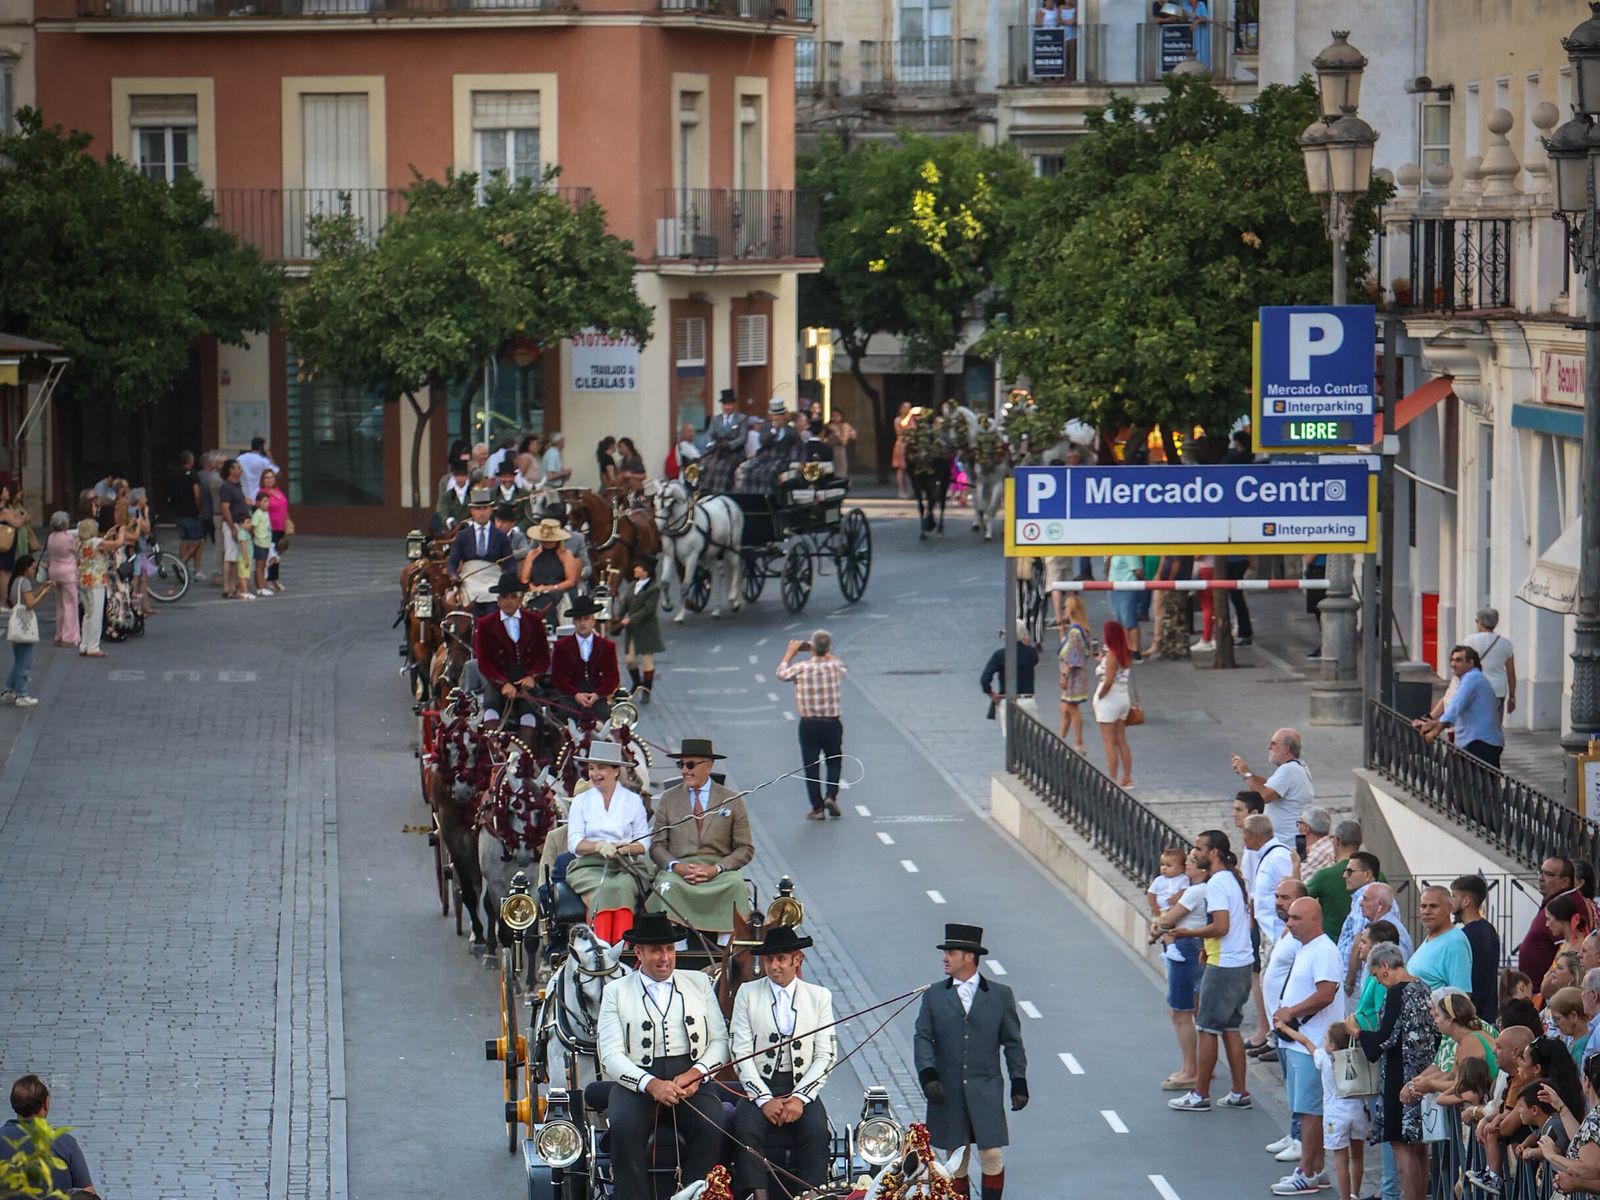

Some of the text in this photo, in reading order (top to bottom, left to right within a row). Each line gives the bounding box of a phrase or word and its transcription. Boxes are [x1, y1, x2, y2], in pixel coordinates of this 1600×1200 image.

[1289, 313, 1344, 381] P
[1267, 383, 1321, 395] Mercado
[1288, 400, 1363, 413] Interparking
[1290, 422, 1338, 440] LIBRE
[1027, 473, 1057, 514] P
[1085, 477, 1224, 504] Mercado
[1278, 522, 1356, 537] Interparking
